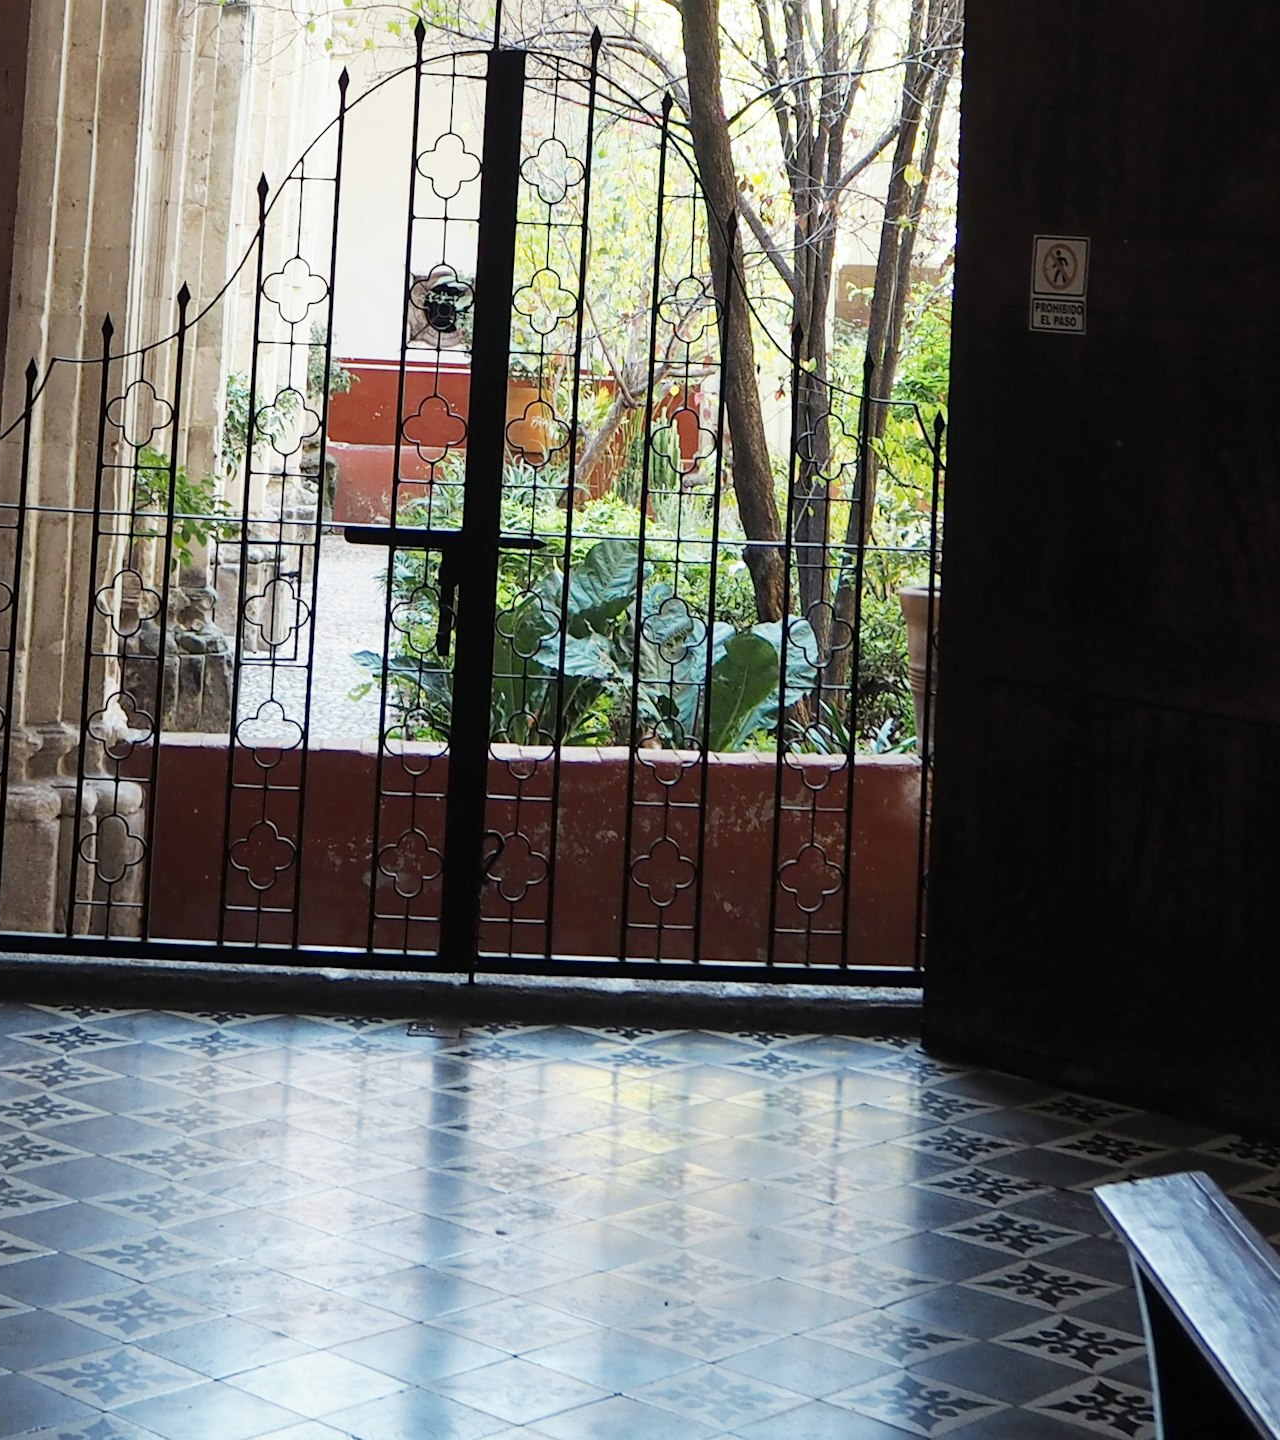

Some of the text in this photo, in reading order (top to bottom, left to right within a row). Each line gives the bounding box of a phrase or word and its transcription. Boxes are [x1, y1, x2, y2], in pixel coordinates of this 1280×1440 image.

[1035, 302, 1083, 315] PROHIBIDO
[1041, 315, 1076, 327] EL PASO
